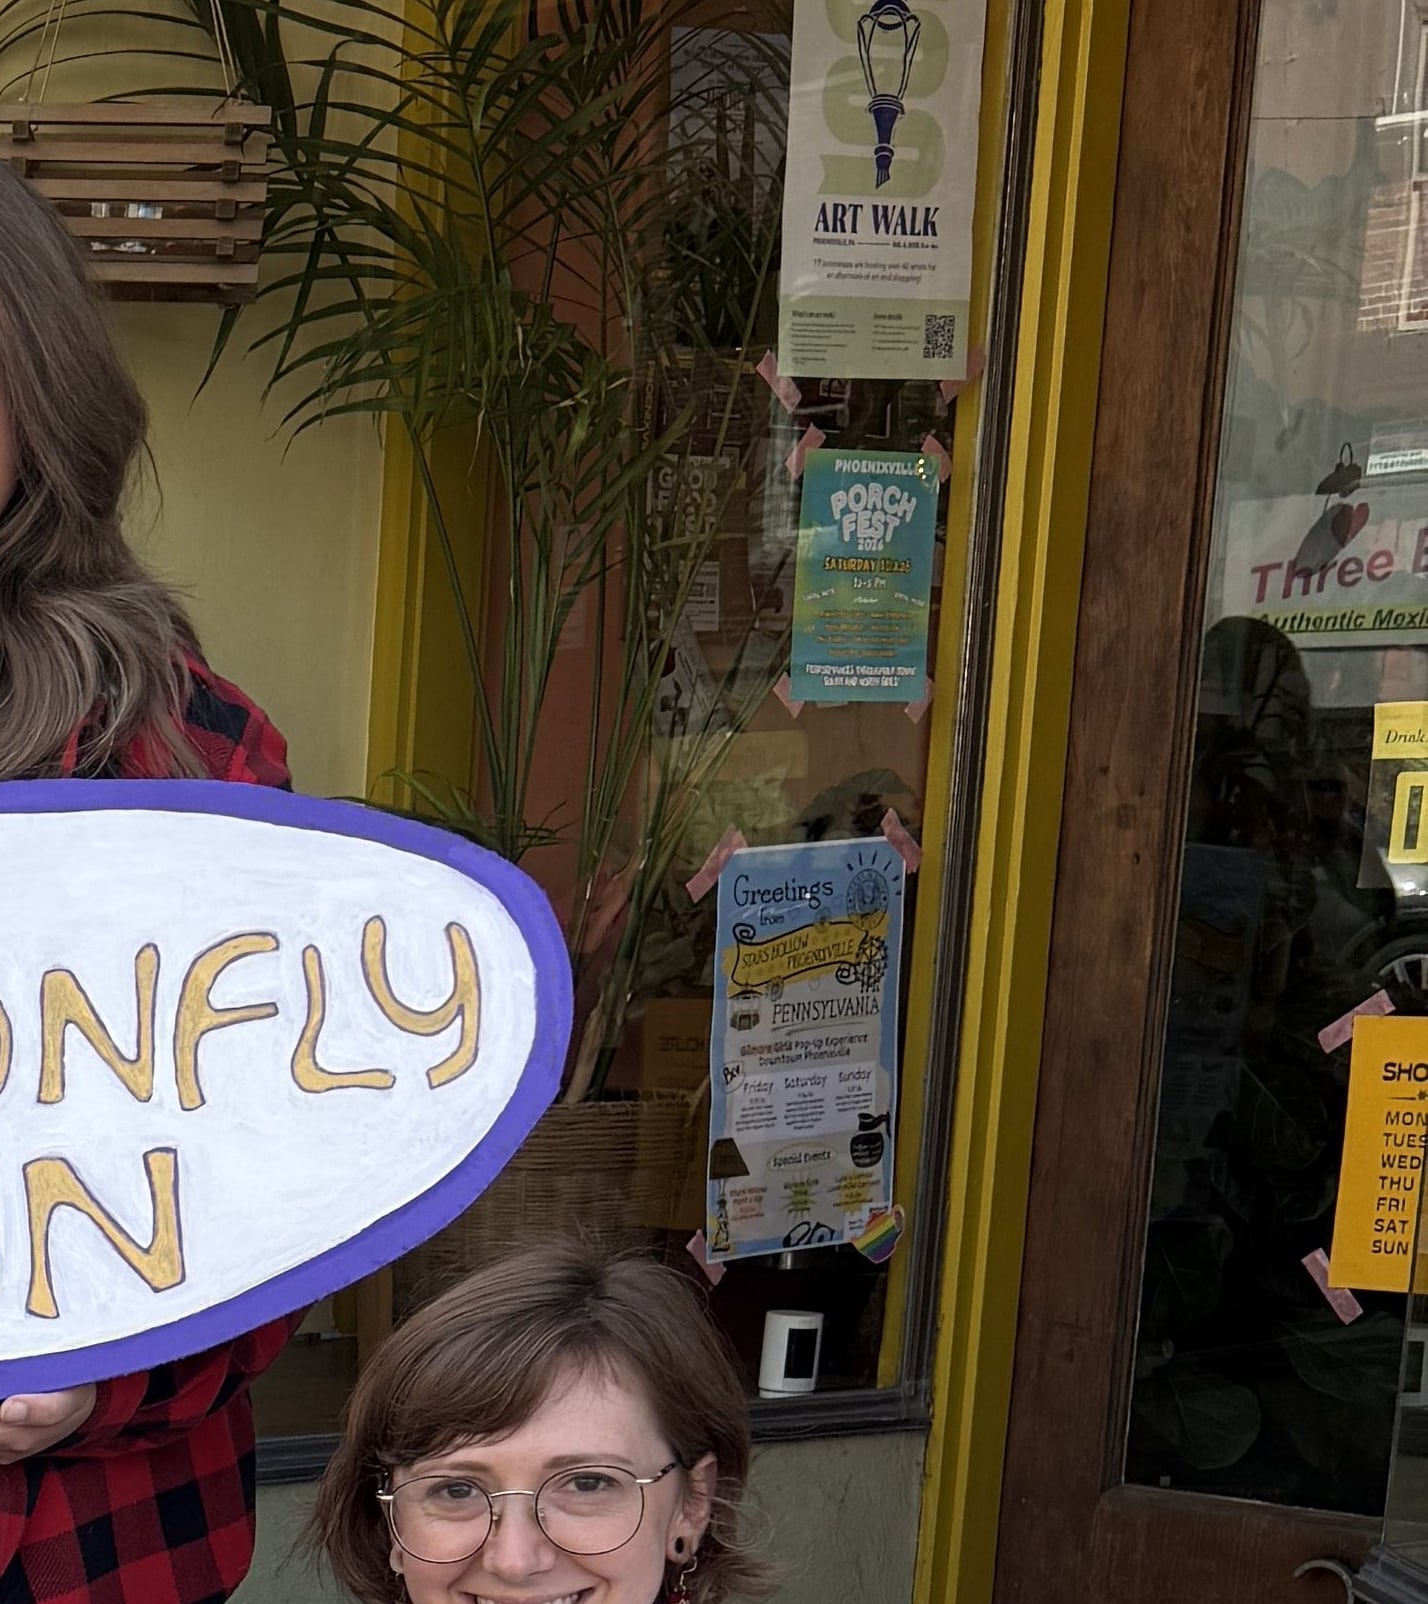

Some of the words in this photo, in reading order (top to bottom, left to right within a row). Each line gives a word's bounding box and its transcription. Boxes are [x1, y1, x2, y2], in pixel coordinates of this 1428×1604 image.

[814, 202, 863, 233] ART
[872, 204, 940, 237] WALK
[830, 482, 917, 523] PORCH
[842, 509, 901, 543] FEST
[1251, 551, 1394, 604] Three
[734, 874, 834, 910] Greetings
[760, 907, 785, 926] from
[772, 934, 810, 962] HOLLOW
[787, 939, 854, 970] PHOENIXVILLE
[772, 995, 880, 1025] PENNSYLVANIA
[744, 1080, 774, 1095] Friday
[784, 1074, 828, 1091] Saturday
[838, 1067, 872, 1084] Sunday
[1382, 1062, 1428, 1082] SHO
[1385, 1111, 1428, 1126] MON
[1383, 1133, 1428, 1148] TUES
[1381, 1154, 1422, 1170] WED
[1378, 1176, 1415, 1191] THU
[1376, 1197, 1406, 1212] FRI
[1374, 1219, 1409, 1234] SAT
[1371, 1239, 1409, 1255] SUN
